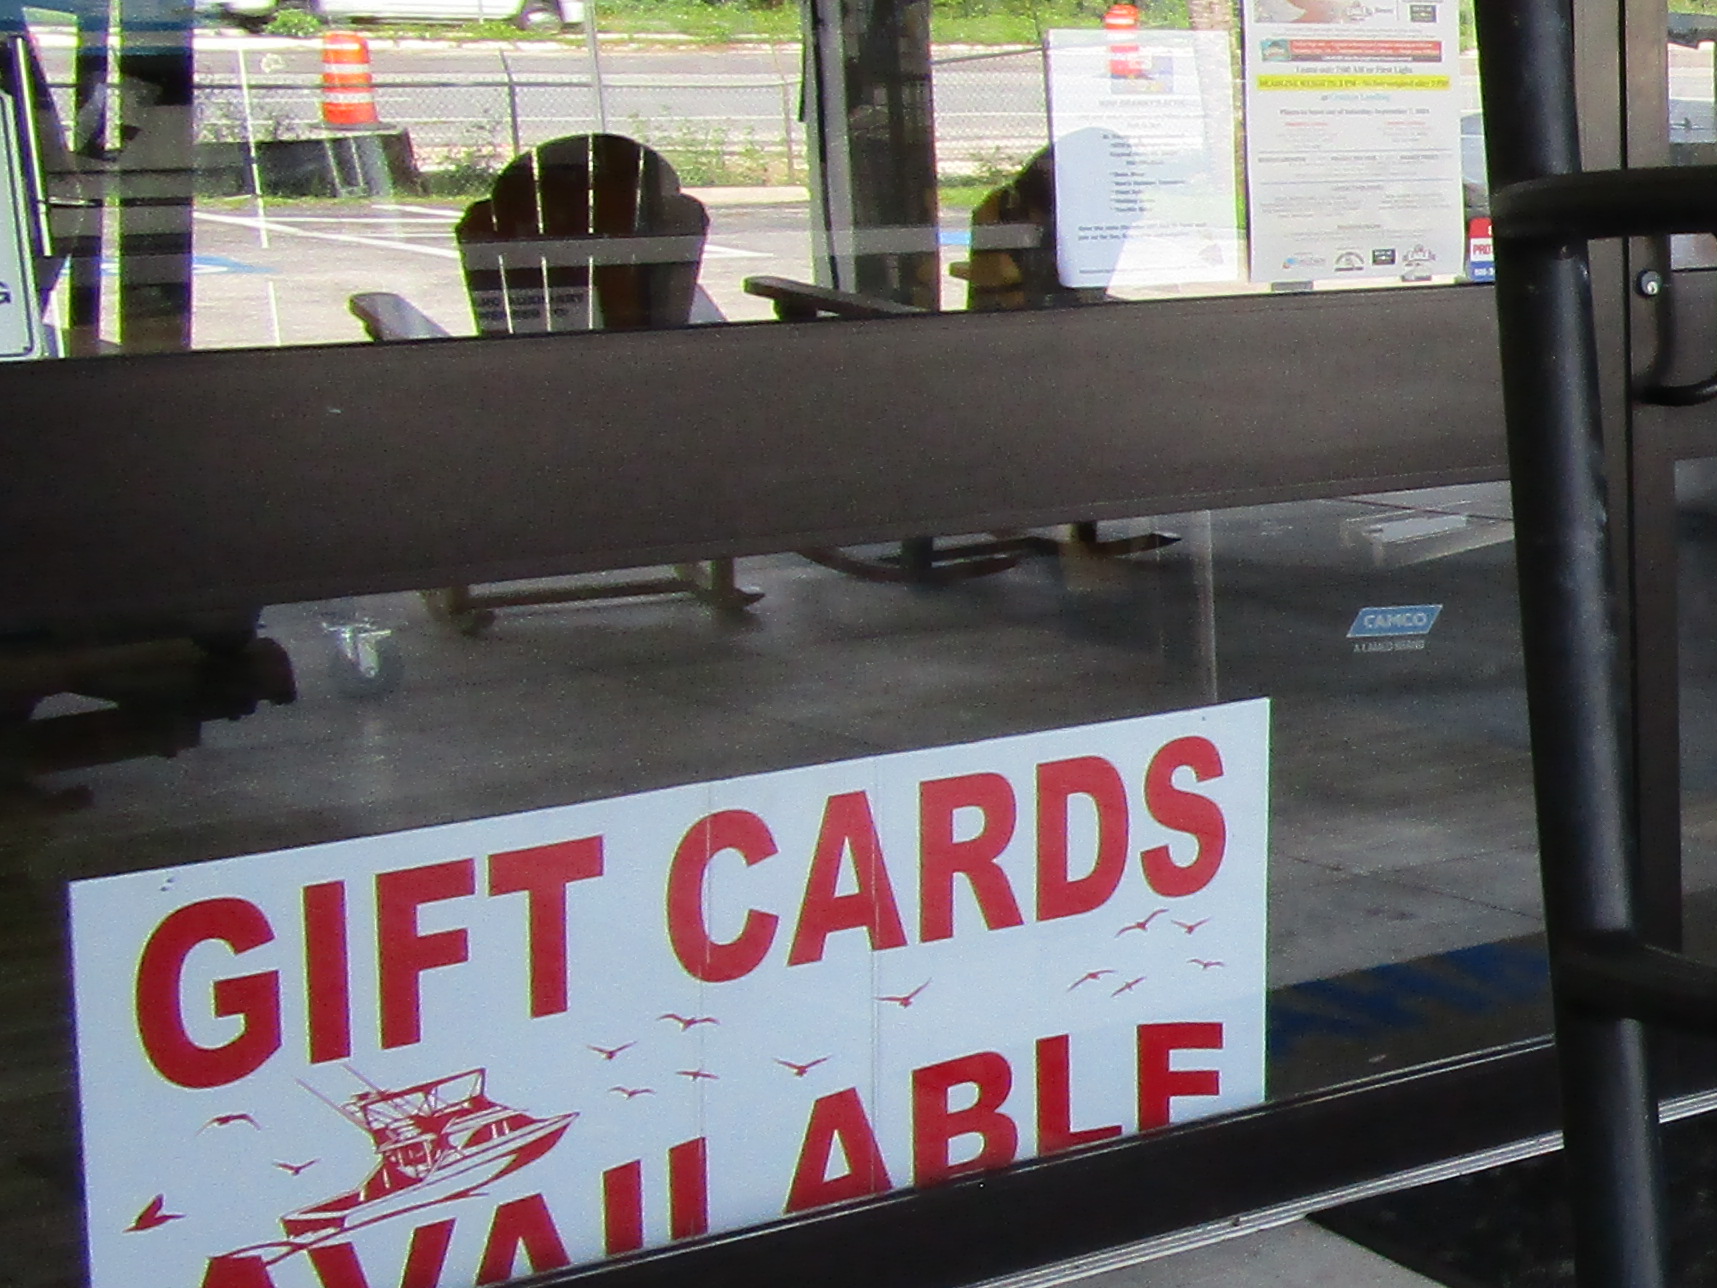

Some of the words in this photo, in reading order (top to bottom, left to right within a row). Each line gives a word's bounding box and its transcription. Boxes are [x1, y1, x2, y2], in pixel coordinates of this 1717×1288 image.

[1363, 612, 1428, 629] CAMCO
[133, 834, 605, 1090] GIFT
[664, 733, 1228, 985] CARDS
